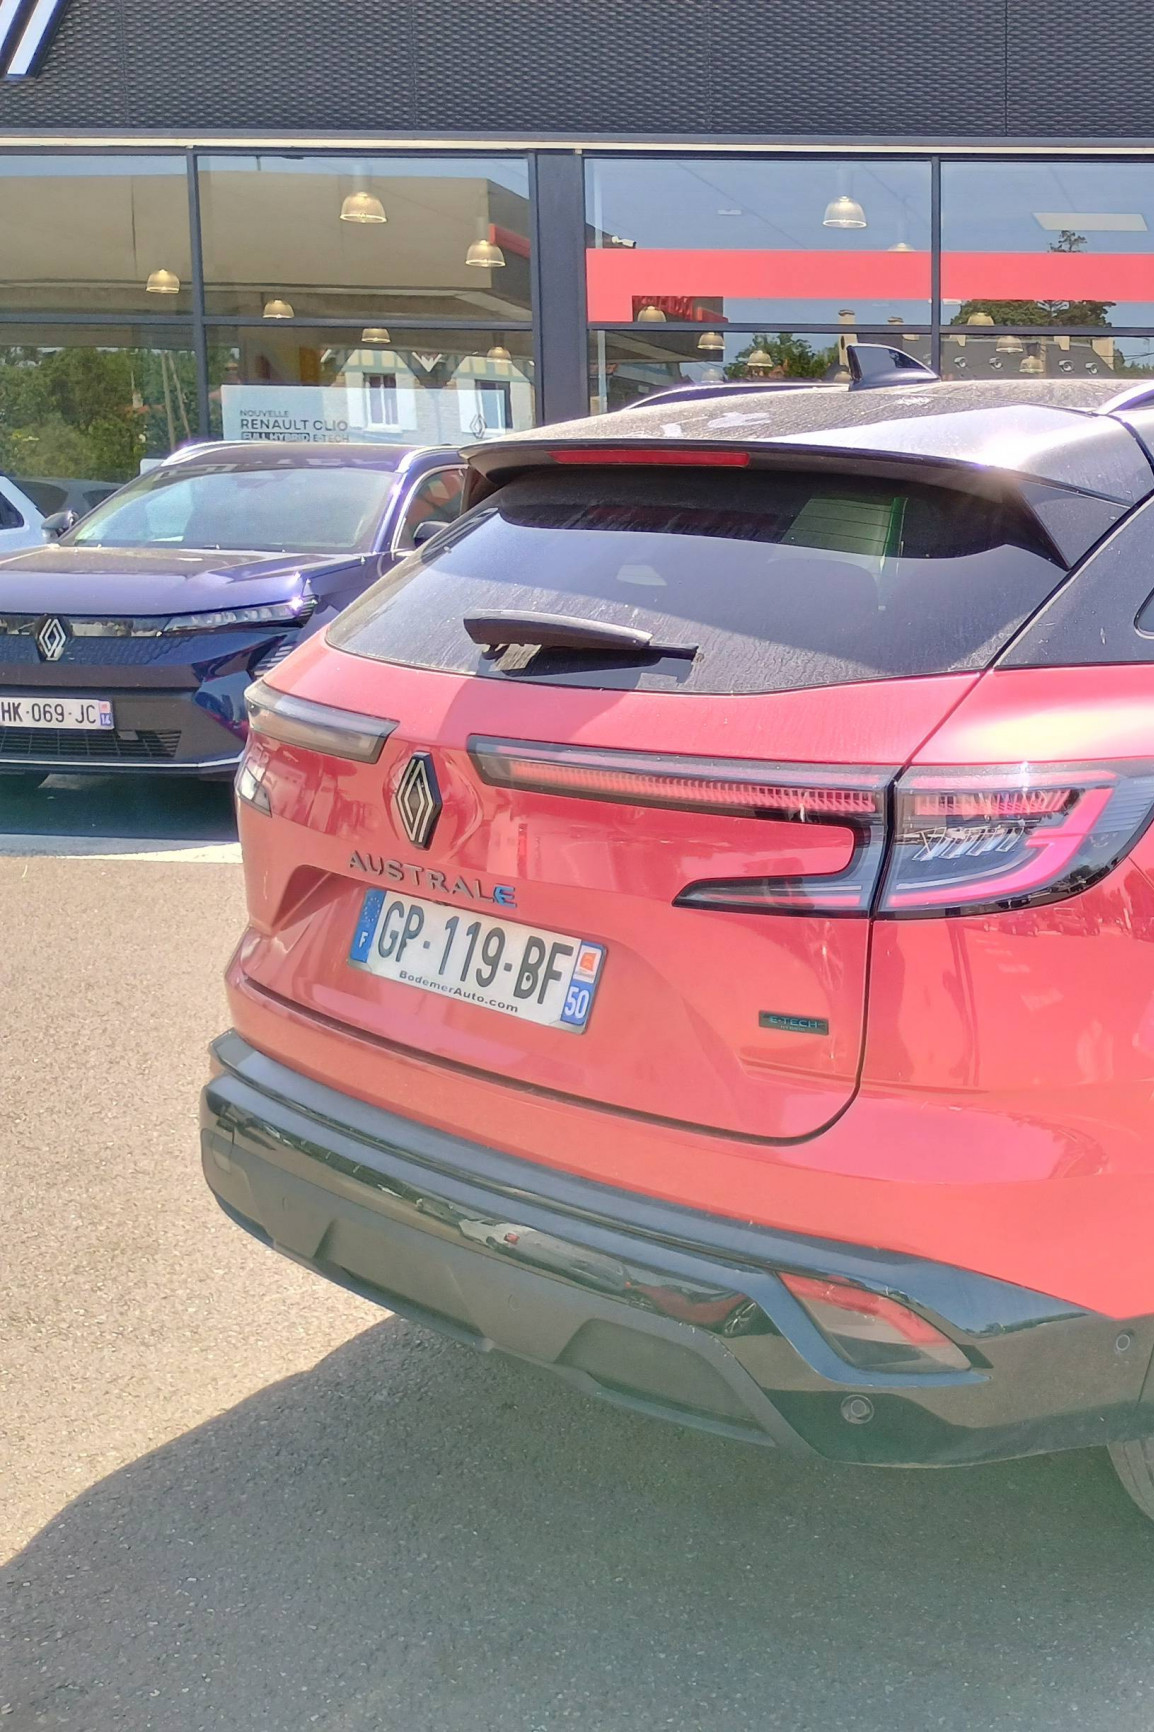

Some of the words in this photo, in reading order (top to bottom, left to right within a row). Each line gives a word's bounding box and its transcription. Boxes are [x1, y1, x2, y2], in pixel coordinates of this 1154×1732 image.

[240, 410, 289, 418] NOUVELLE
[241, 419, 309, 430] RENAULT
[313, 420, 348, 432] CLIO
[350, 850, 518, 908] AUSTRALE
[358, 931, 369, 949] F
[399, 970, 519, 1013] BodemerAuto.com
[564, 986, 590, 1020] 50
